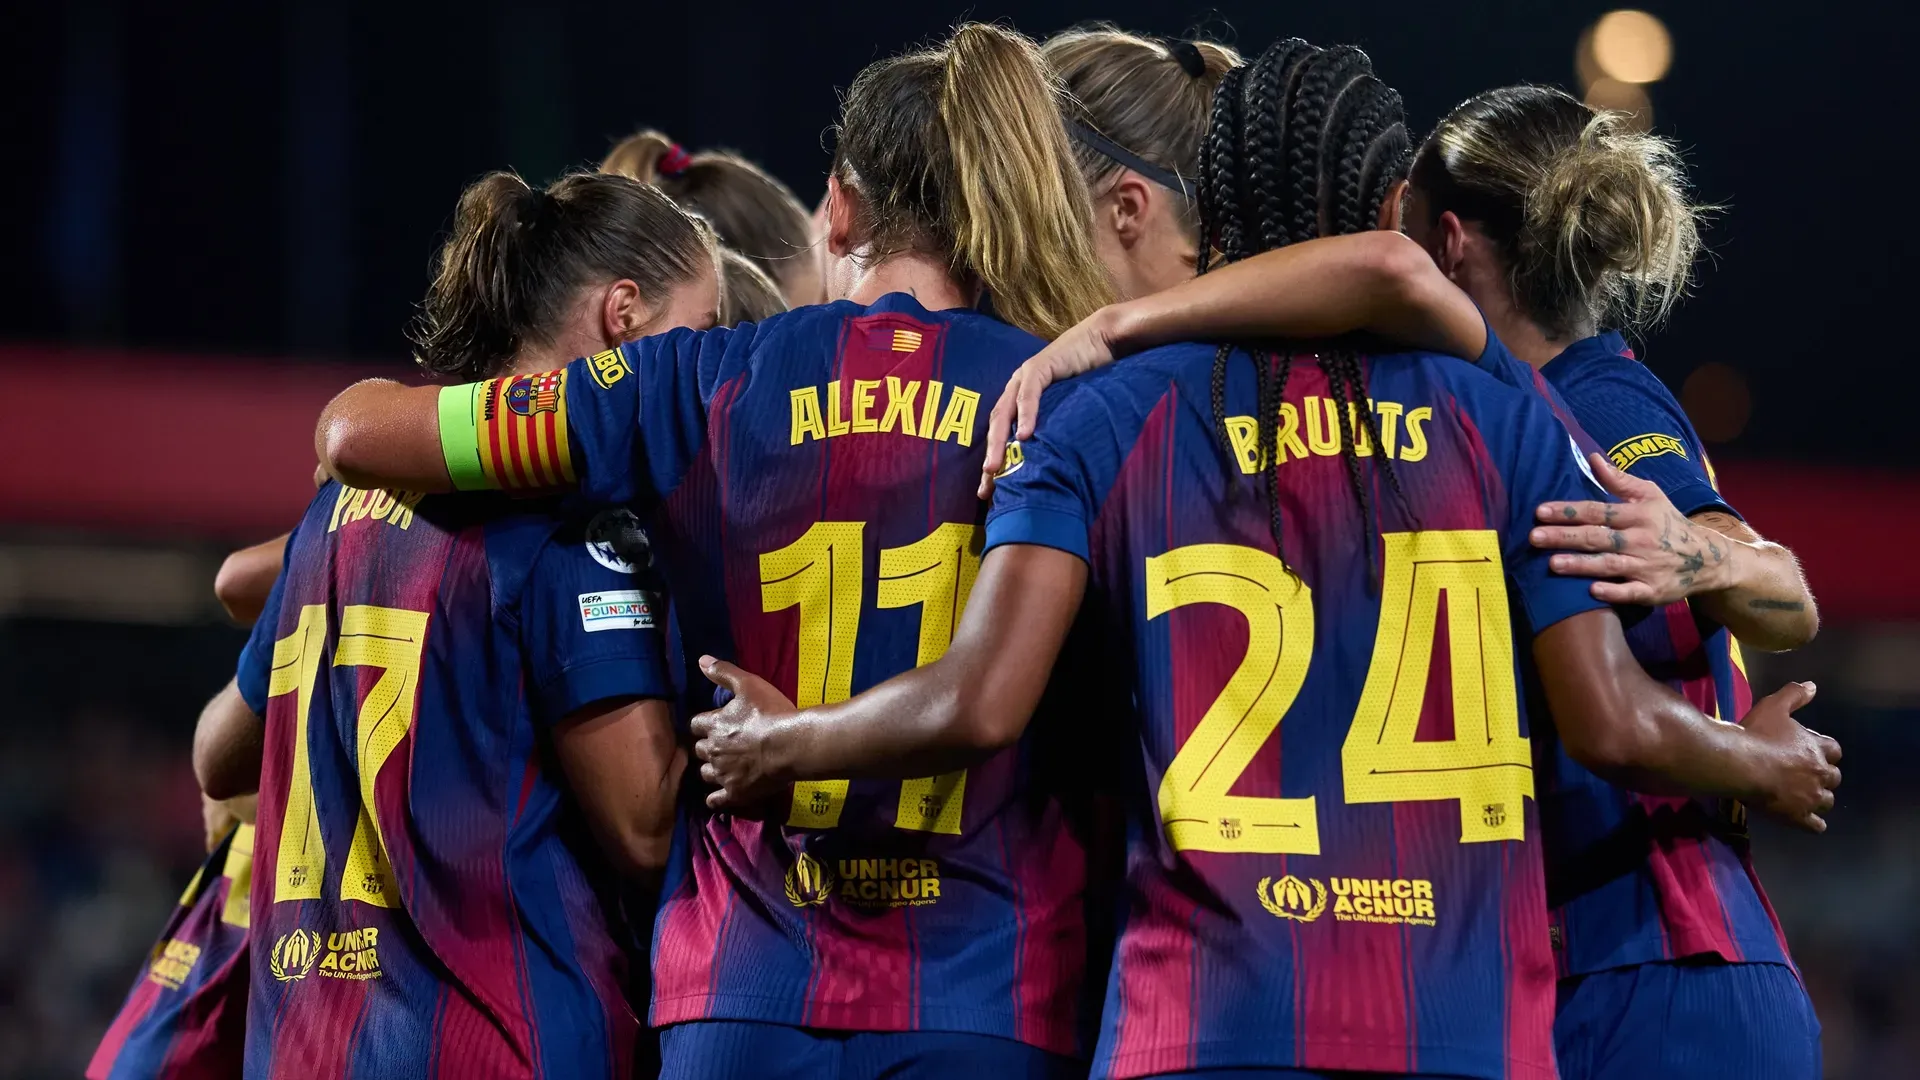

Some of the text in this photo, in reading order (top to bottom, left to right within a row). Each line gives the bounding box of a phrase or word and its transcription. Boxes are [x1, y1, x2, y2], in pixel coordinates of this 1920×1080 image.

[789, 376, 981, 447] ALEXIA
[1610, 436, 1687, 470] BIMBO
[581, 595, 602, 604] UEFA
[583, 604, 652, 618] FOUNDATIO
[759, 521, 983, 835] 11
[1146, 530, 1535, 855] 24
[268, 604, 430, 908] 17
[838, 858, 940, 879] UNHCR
[841, 878, 941, 900] ACNUR
[1330, 877, 1433, 899] UNHCR
[1333, 895, 1436, 918] ACNUR
[1335, 912, 1436, 927] The UN Refugee Agency
[318, 969, 333, 978] The
[333, 970, 347, 979] UN
